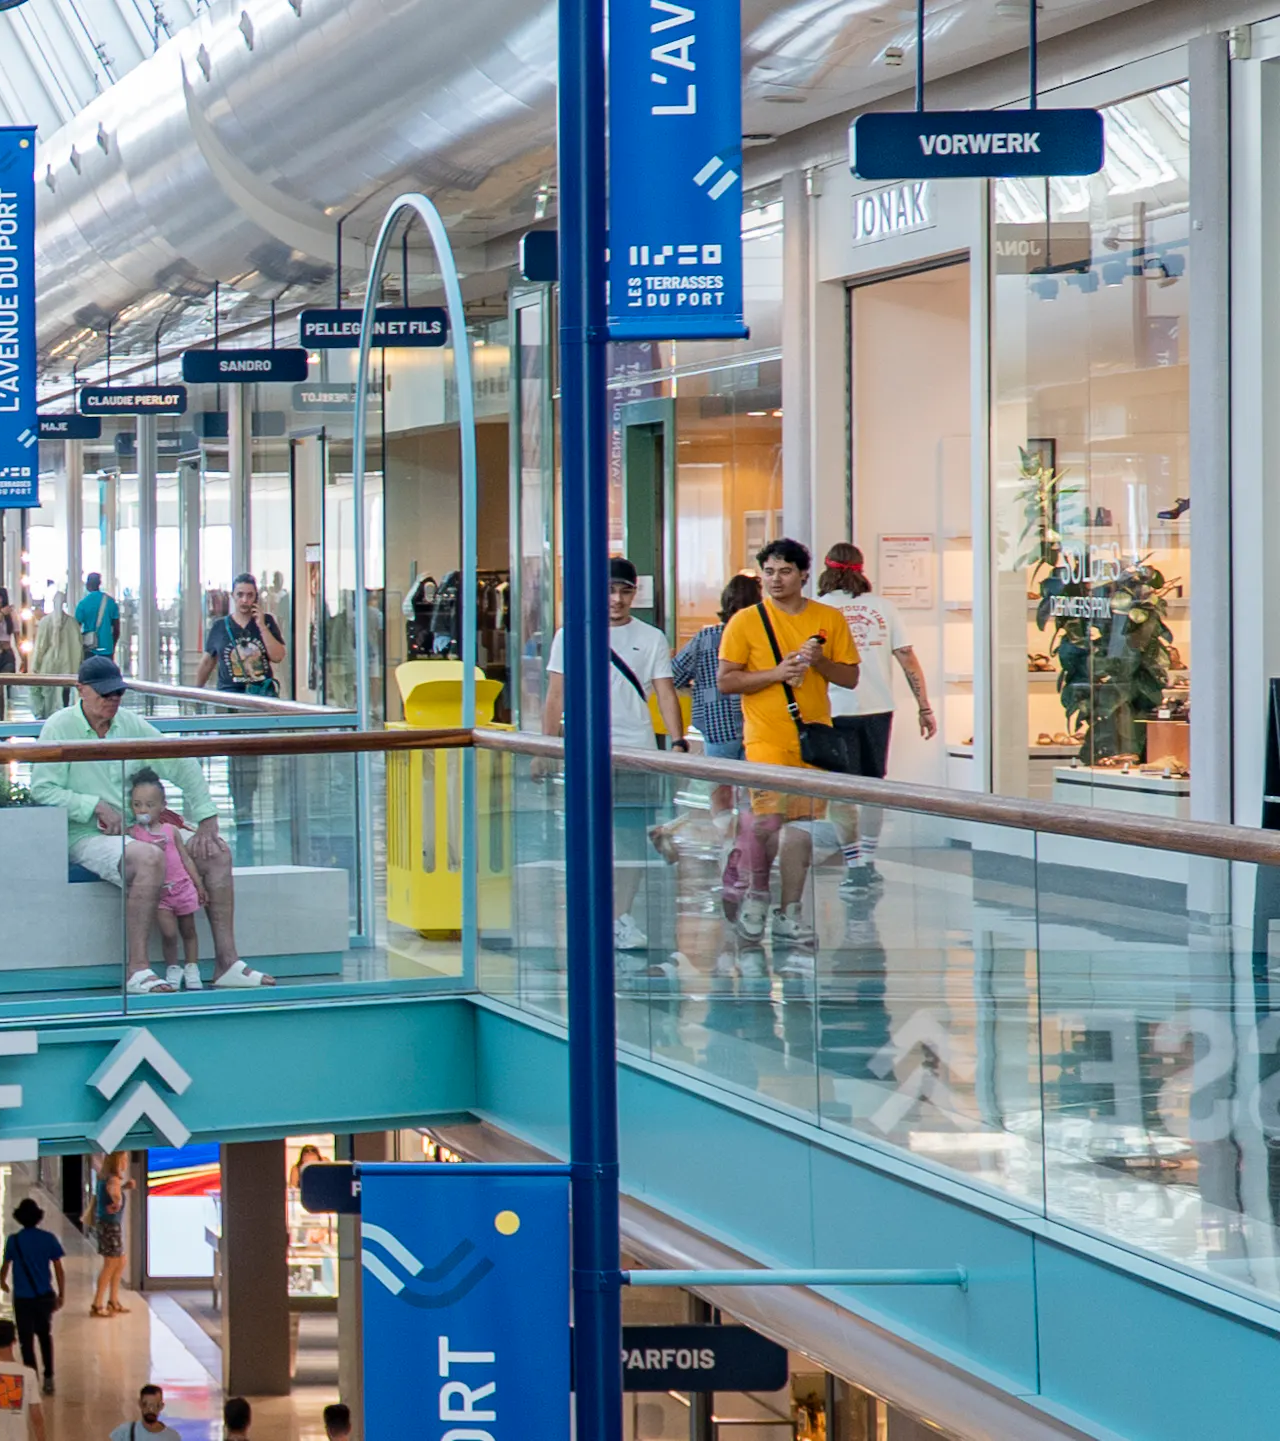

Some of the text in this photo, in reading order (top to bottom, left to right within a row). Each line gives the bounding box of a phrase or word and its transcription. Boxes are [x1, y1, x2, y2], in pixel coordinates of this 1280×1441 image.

[919, 132, 1041, 155] VORWERK
[852, 180, 930, 241] JONAK
[645, 275, 725, 290] TERRASSES
[627, 277, 642, 307] LES
[646, 291, 725, 308] DU PORT
[305, 321, 442, 336] PELLEGN ET FILS
[219, 359, 272, 372] SANDRO
[87, 394, 180, 406] CLAUDIE PIERLOT
[40, 421, 68, 432] MAJE
[1060, 542, 1121, 585] SOLDES
[621, 1348, 716, 1370] PARFOIS
